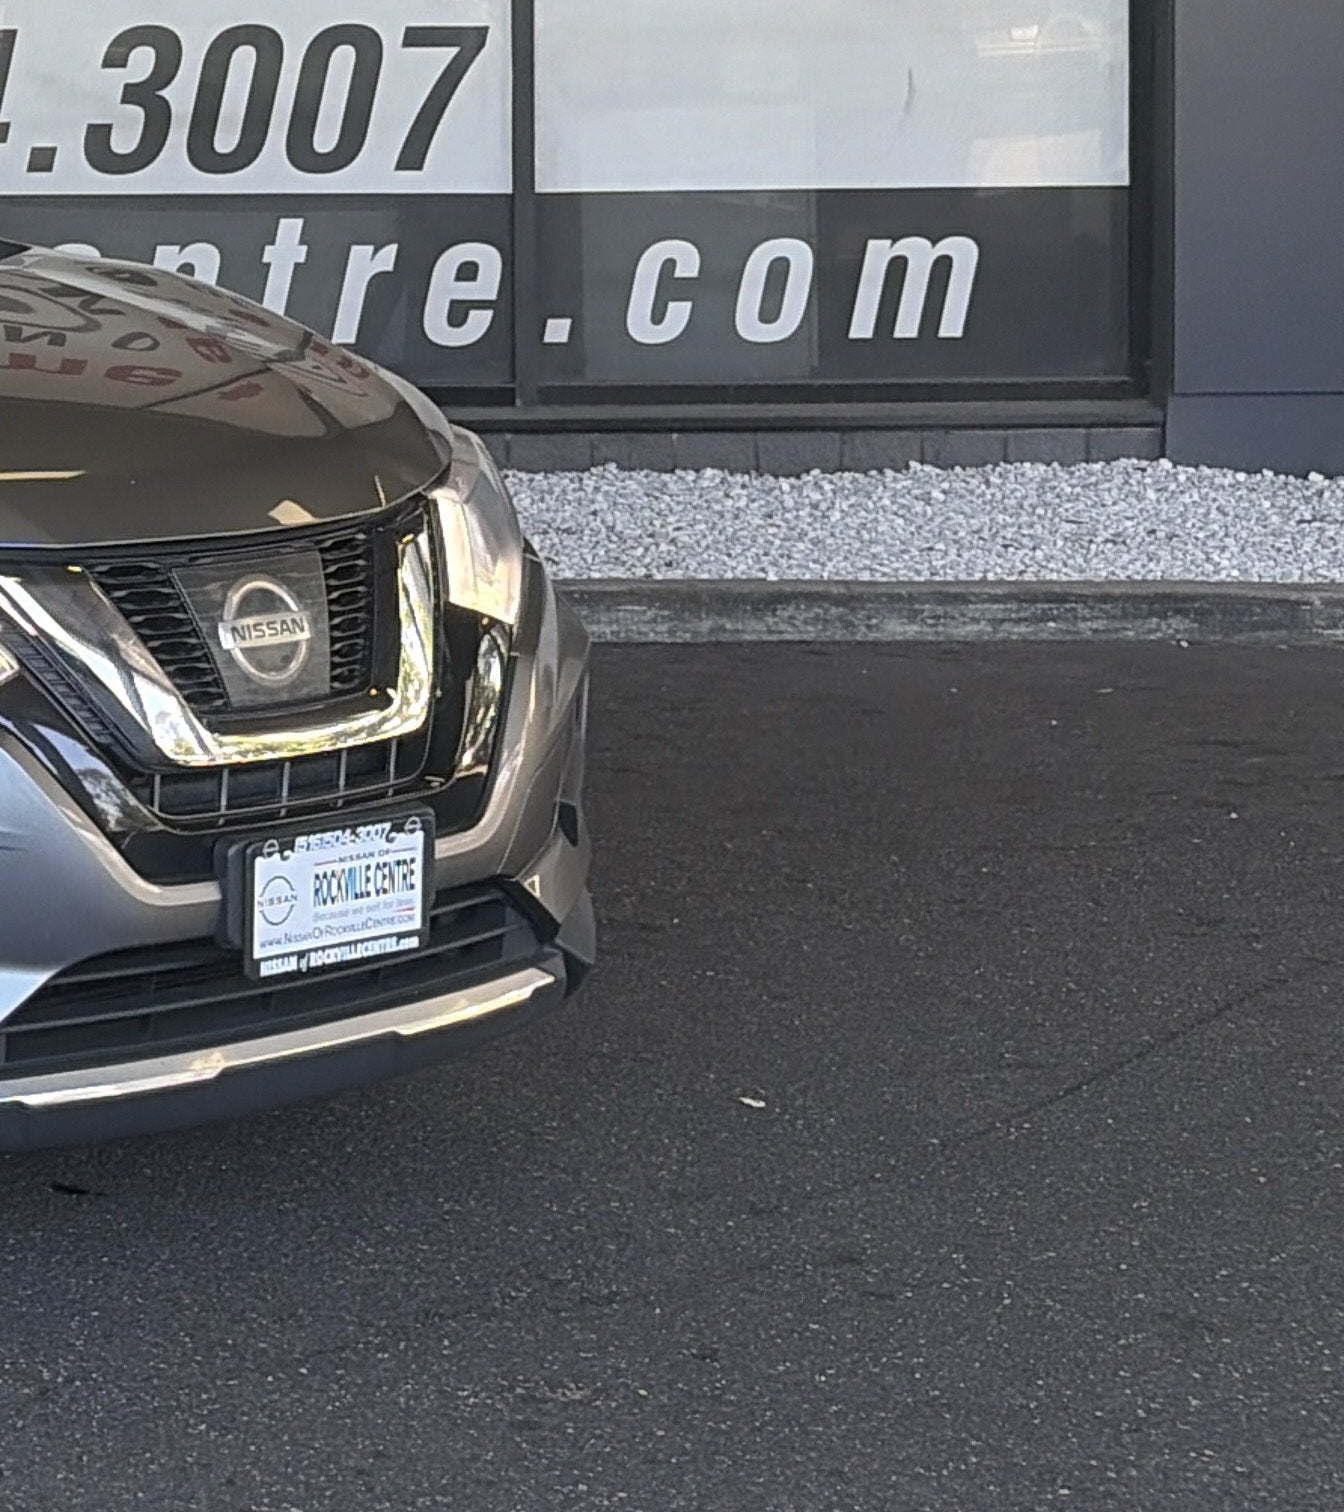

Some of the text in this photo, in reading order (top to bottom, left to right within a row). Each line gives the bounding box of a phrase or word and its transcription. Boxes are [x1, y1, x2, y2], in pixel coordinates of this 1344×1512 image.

[230, 616, 306, 643] NISSAN
[313, 857, 416, 907] ROCKVILLE CENTRE
[257, 893, 298, 907] NISSAN
